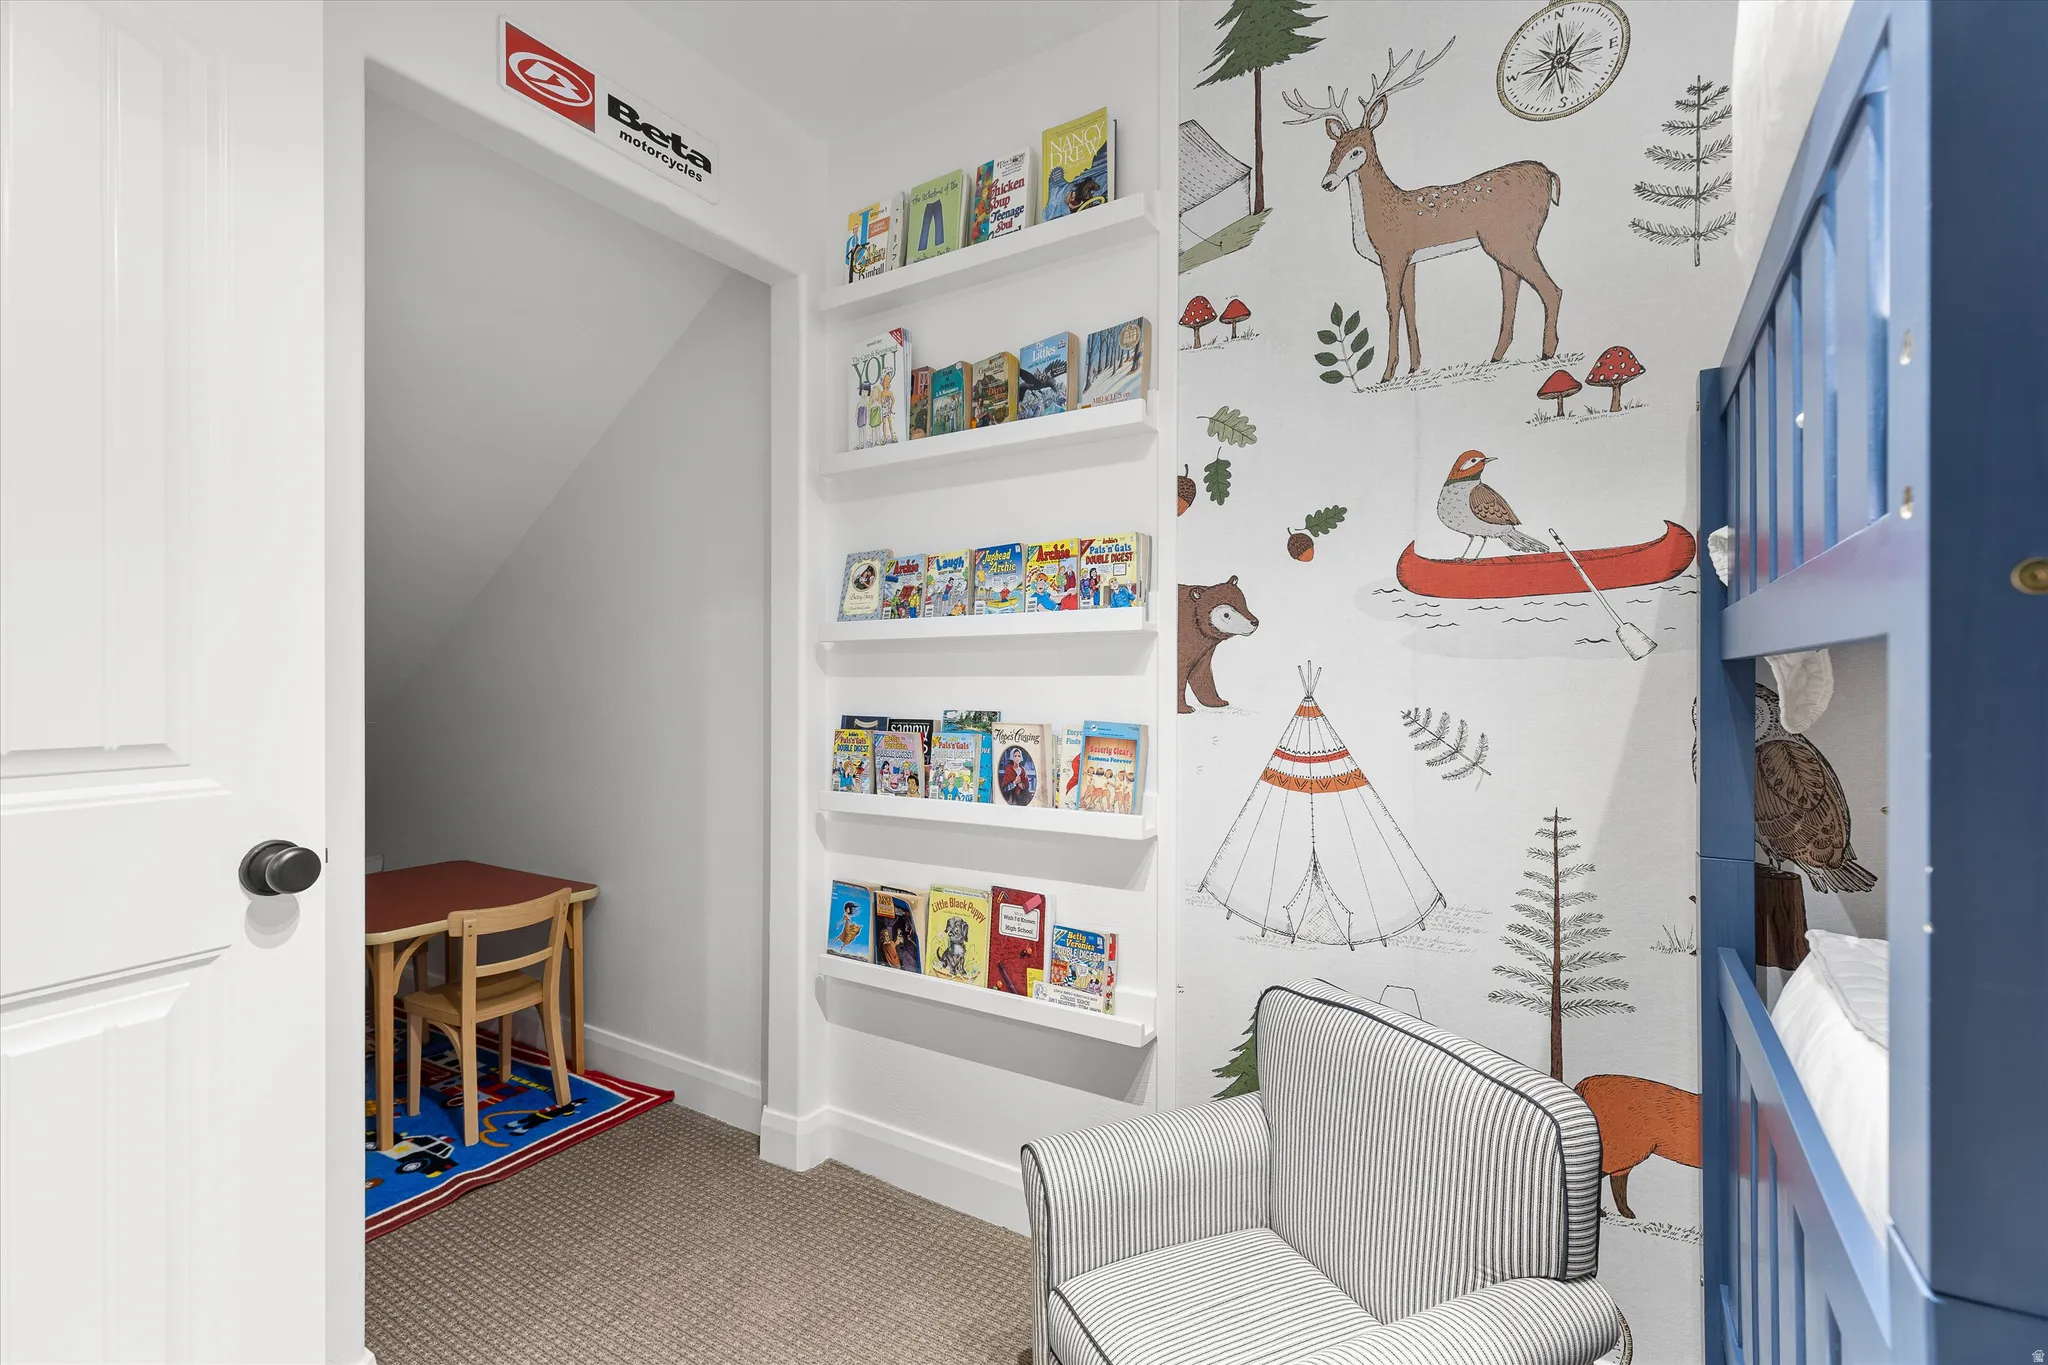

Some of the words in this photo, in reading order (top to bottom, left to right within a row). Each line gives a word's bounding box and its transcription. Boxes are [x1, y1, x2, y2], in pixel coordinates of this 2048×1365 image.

[1554, 8, 1565, 20] N
[1608, 36, 1619, 49] E
[1506, 72, 1521, 83] W
[1557, 96, 1569, 109] S
[607, 93, 712, 174] Beta
[1050, 120, 1105, 153] NANCY
[619, 129, 703, 183] motorcycles
[1050, 140, 1098, 171] DREW
[987, 177, 1025, 200] Chicken
[985, 195, 1011, 215] Soup
[990, 205, 1025, 224] Teenage
[995, 218, 1013, 233] Soul
[1032, 346, 1056, 362] Littles
[852, 350, 898, 388] YOU
[982, 548, 1012, 565] Jughead
[1036, 544, 1071, 562] Archie
[1089, 546, 1106, 555] Pals
[1114, 543, 1132, 552] Gals
[936, 556, 965, 571] Laugh
[1085, 553, 1110, 565] DOUBLE
[1110, 551, 1133, 563] DIGEST
[893, 559, 919, 575] Archie
[988, 560, 1016, 574] Archie
[890, 719, 930, 742] sammy
[993, 728, 1014, 745] Hope's
[1013, 728, 1040, 745] Crossing
[1088, 746, 1112, 756] Beverly
[1113, 748, 1133, 758] Cleary
[1109, 757, 1133, 765] Forever
[931, 899, 949, 913] Little
[949, 897, 968, 911] Black
[967, 901, 986, 924] Puppy
[1020, 917, 1036, 925] Known
[1005, 924, 1017, 932] High
[1017, 927, 1034, 935] School
[1067, 931, 1087, 943] Betty
[1066, 939, 1095, 951] Veronica
